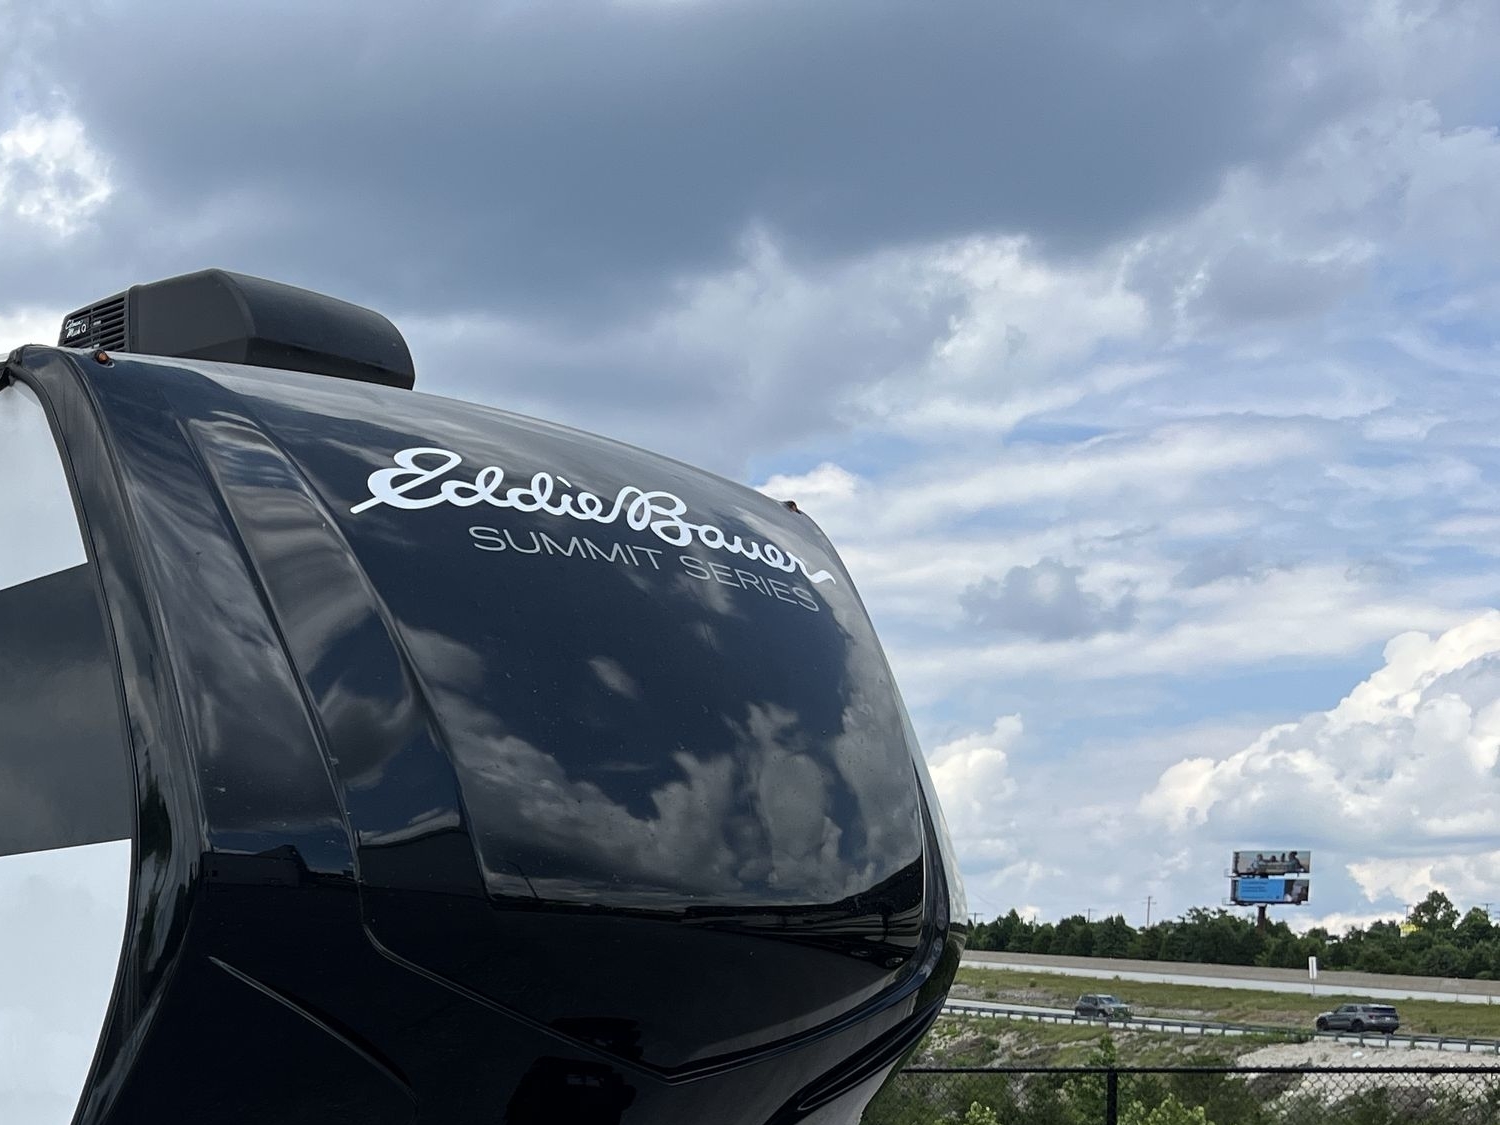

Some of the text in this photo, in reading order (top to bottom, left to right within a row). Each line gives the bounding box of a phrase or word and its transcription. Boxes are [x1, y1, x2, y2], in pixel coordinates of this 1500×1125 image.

[350, 447, 836, 585] Eddie Bauer
[468, 525, 821, 613] SUMMIT SERIES
